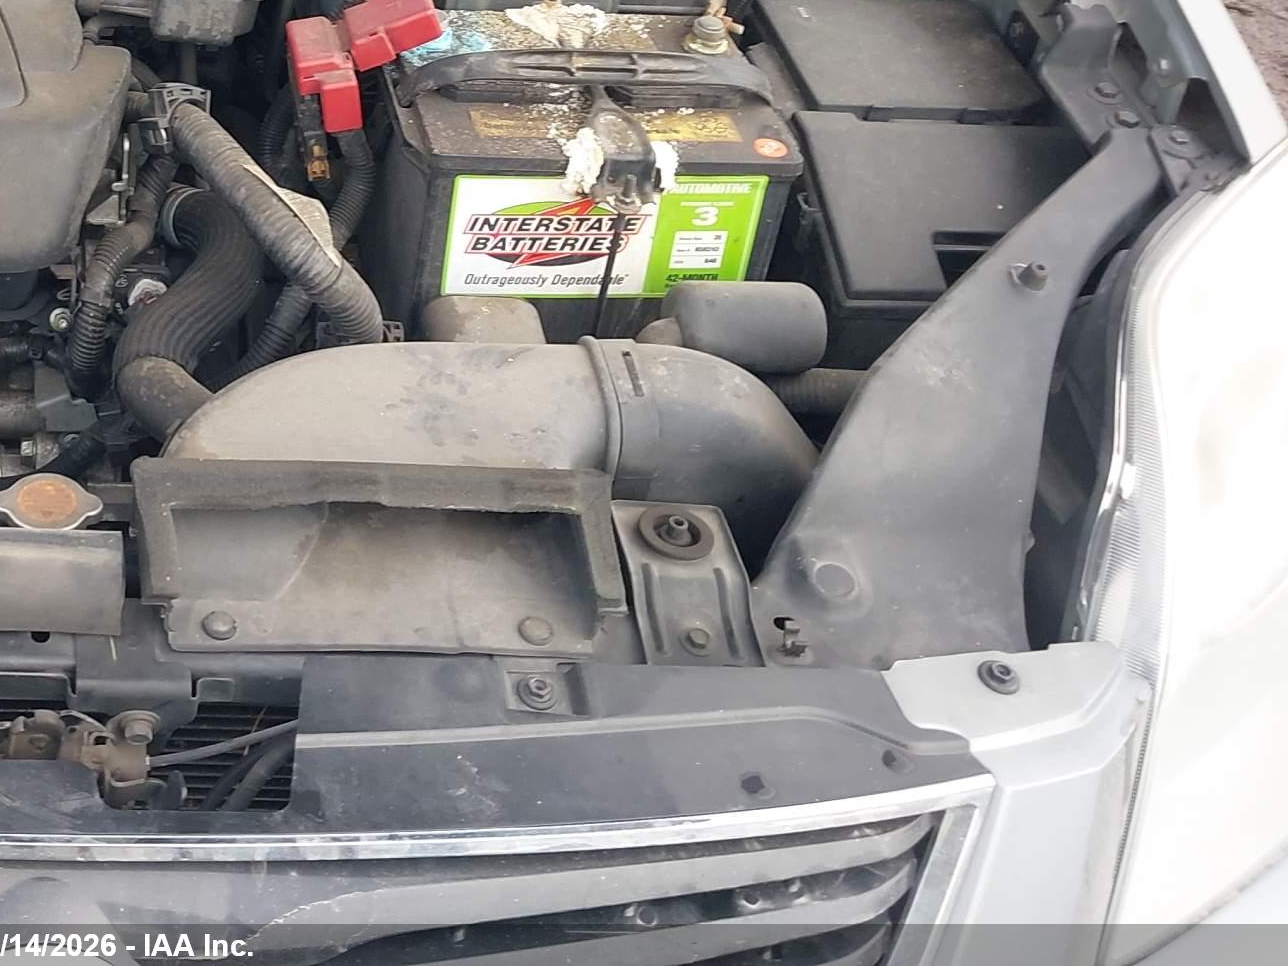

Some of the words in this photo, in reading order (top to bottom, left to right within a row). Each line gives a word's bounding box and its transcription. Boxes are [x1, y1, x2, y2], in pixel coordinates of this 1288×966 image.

[692, 206, 719, 226] 3
[469, 217, 641, 233] INTERSTATE
[464, 273, 548, 288] Outrageously
[551, 273, 625, 288] Dependale
